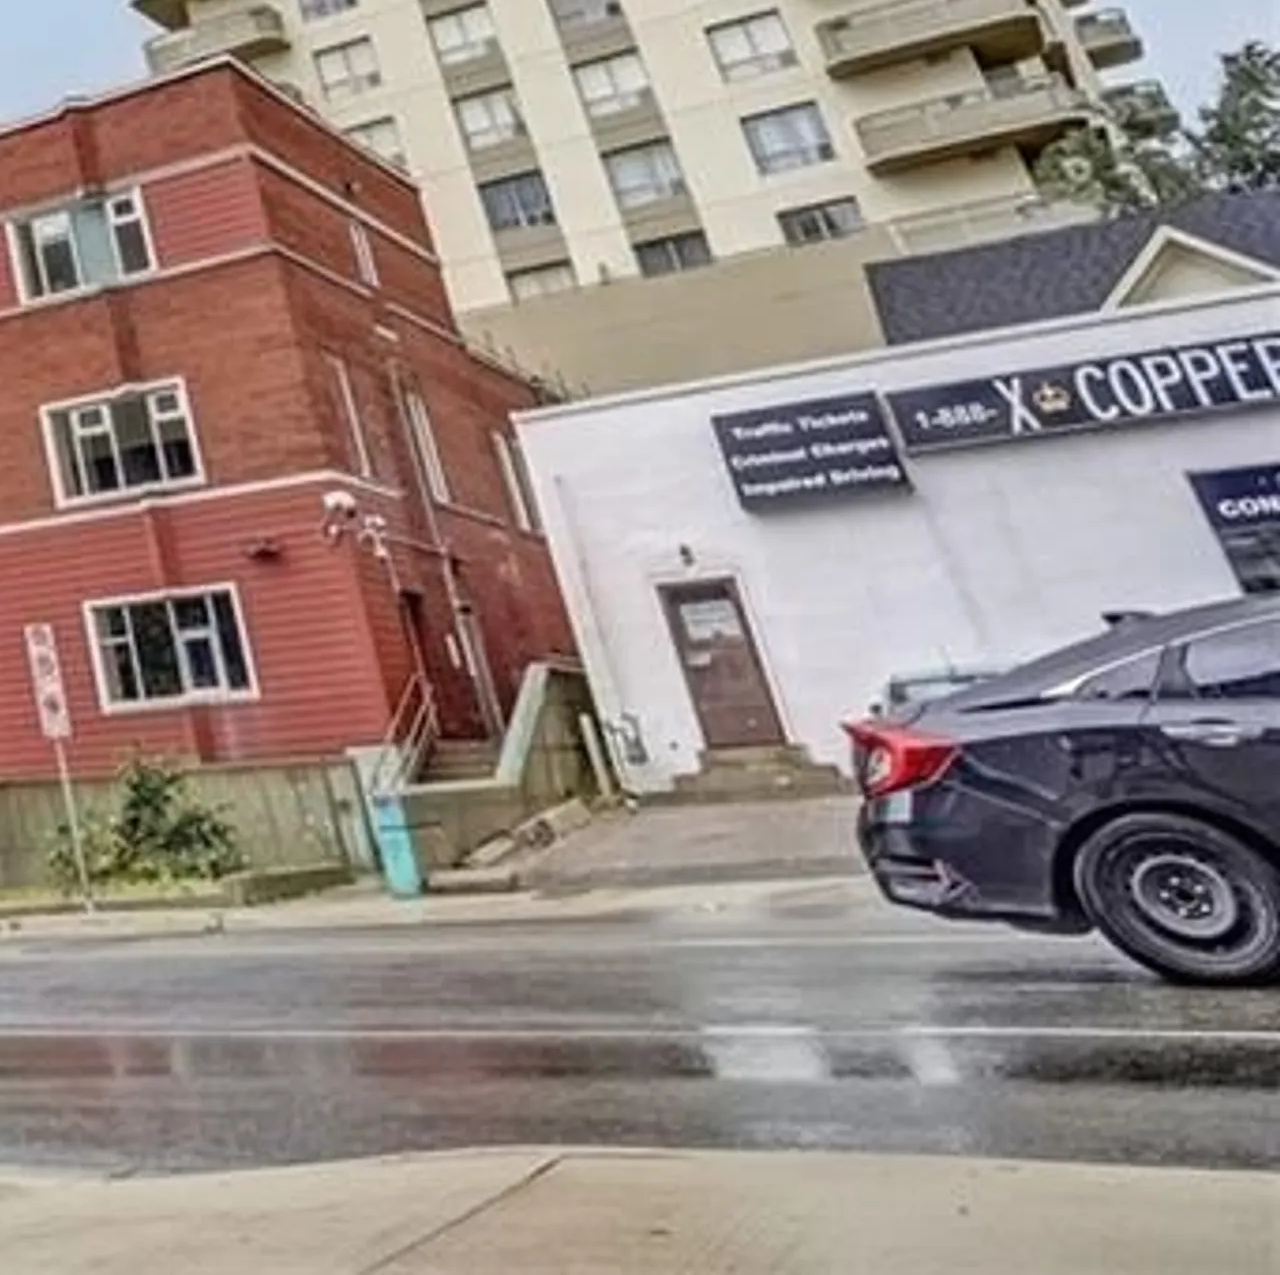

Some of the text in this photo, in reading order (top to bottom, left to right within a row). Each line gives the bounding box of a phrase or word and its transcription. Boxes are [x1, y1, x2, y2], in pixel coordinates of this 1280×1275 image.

[730, 408, 869, 441] Traffic Tickets
[730, 436, 889, 471] Criminal Charges
[741, 463, 901, 497] Impaired Driving
